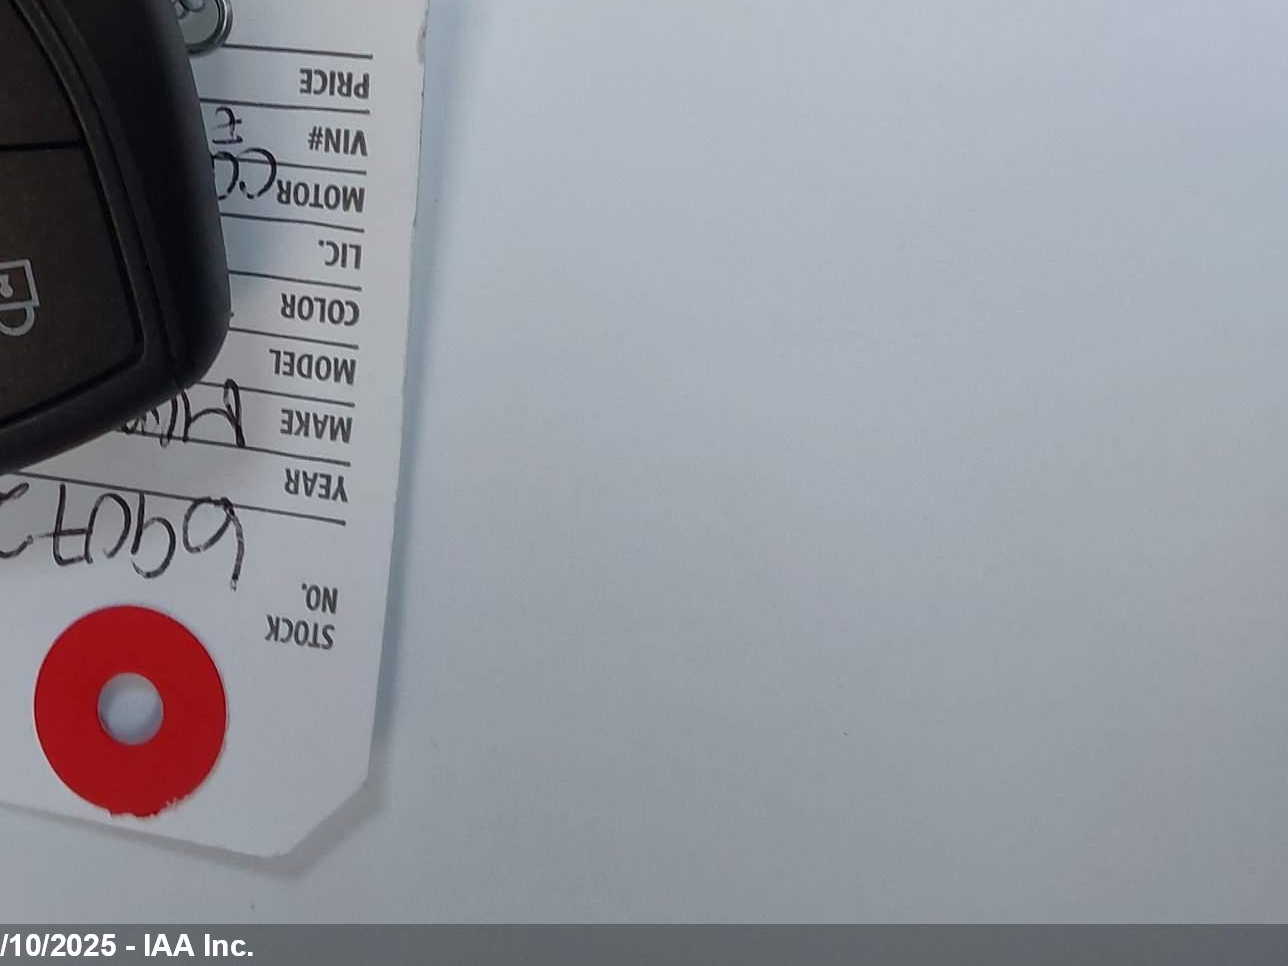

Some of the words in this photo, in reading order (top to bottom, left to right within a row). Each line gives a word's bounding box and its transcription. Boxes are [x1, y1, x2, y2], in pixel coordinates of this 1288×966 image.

[300, 68, 369, 99] PRICE
[308, 126, 367, 156] VIN#
[276, 179, 365, 212] MOTOR
[318, 240, 361, 269] LIC.
[281, 293, 359, 326] COLOR
[269, 347, 357, 385] MODEL
[280, 406, 353, 443] MAKE
[285, 467, 348, 503] YEAR
[302, 583, 338, 614] NO.
[266, 613, 335, 651] STOCK
